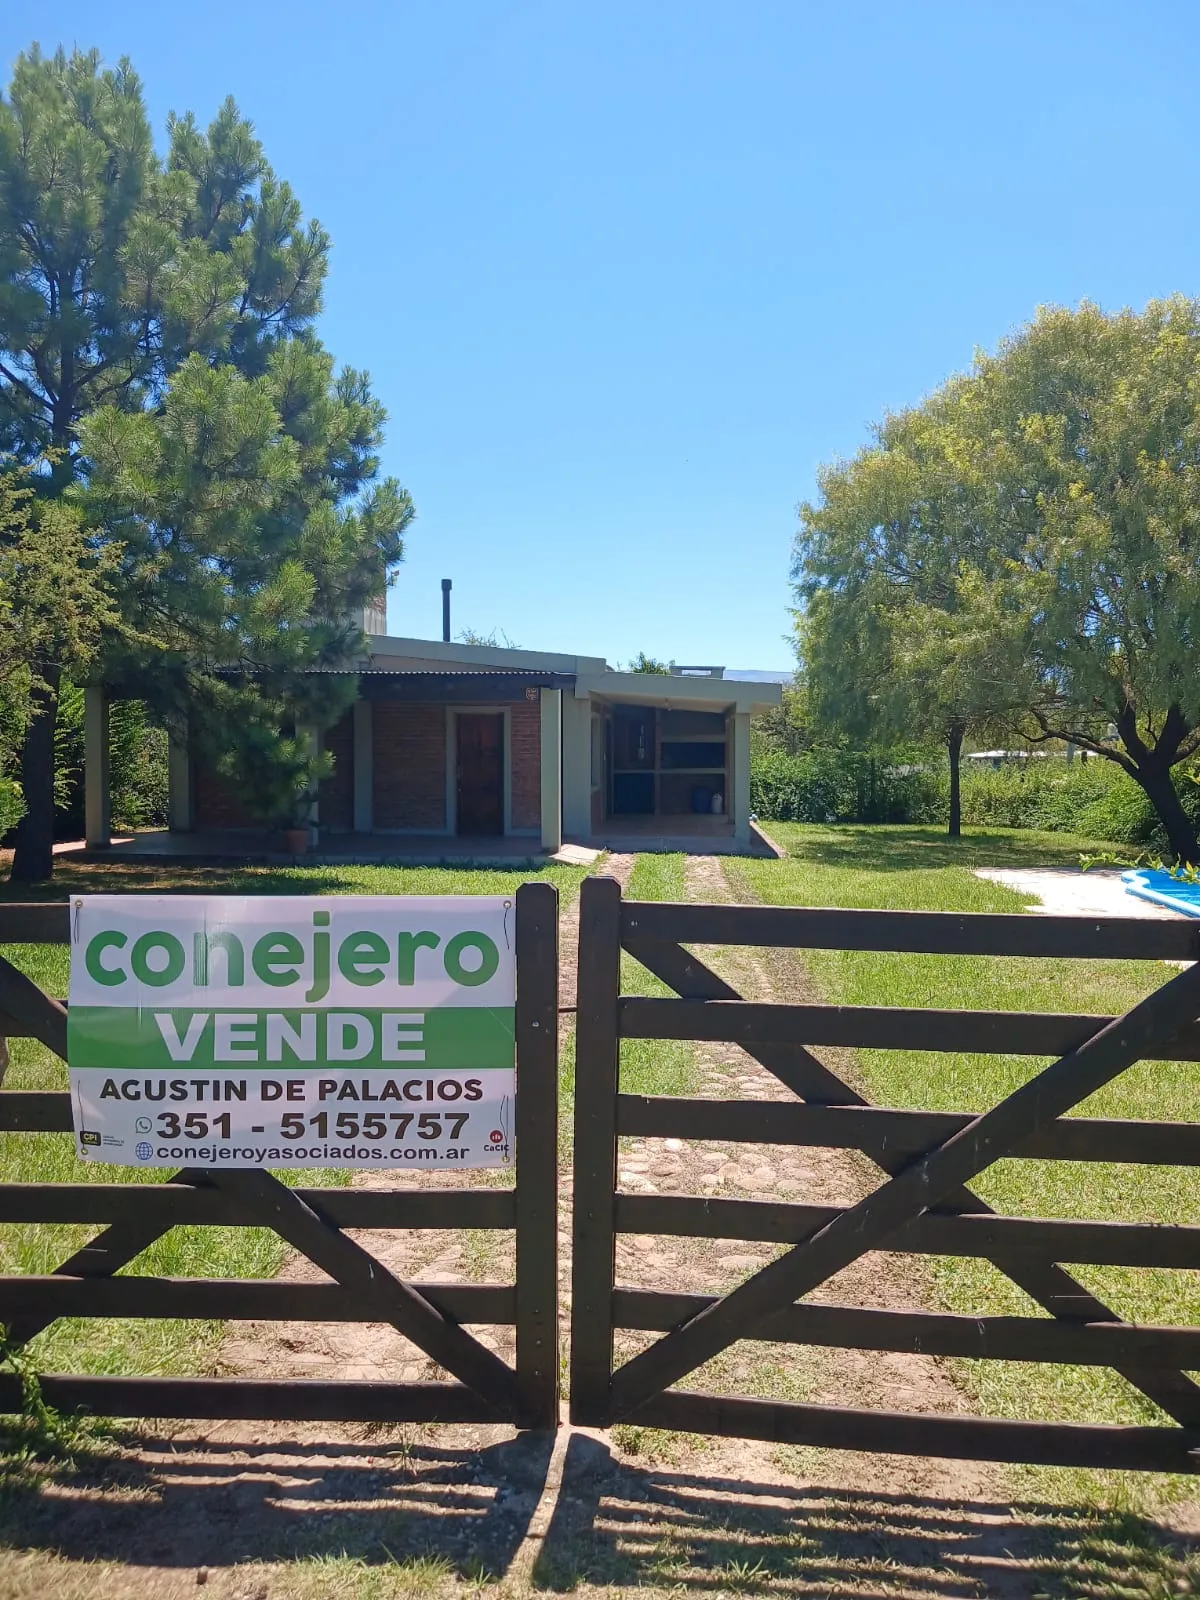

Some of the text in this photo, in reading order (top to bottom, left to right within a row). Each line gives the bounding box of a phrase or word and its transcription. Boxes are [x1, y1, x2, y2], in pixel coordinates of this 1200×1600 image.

[85, 911, 499, 1003] conejero
[155, 1013, 426, 1061] VENDE
[99, 1079, 483, 1101] AGUSTIN DE PALACIOS
[83, 1133, 98, 1141] CPI
[156, 1112, 231, 1140] 351
[280, 1112, 469, 1140] 5155757
[156, 1145, 469, 1162] conejeroyasociados.com.ar
